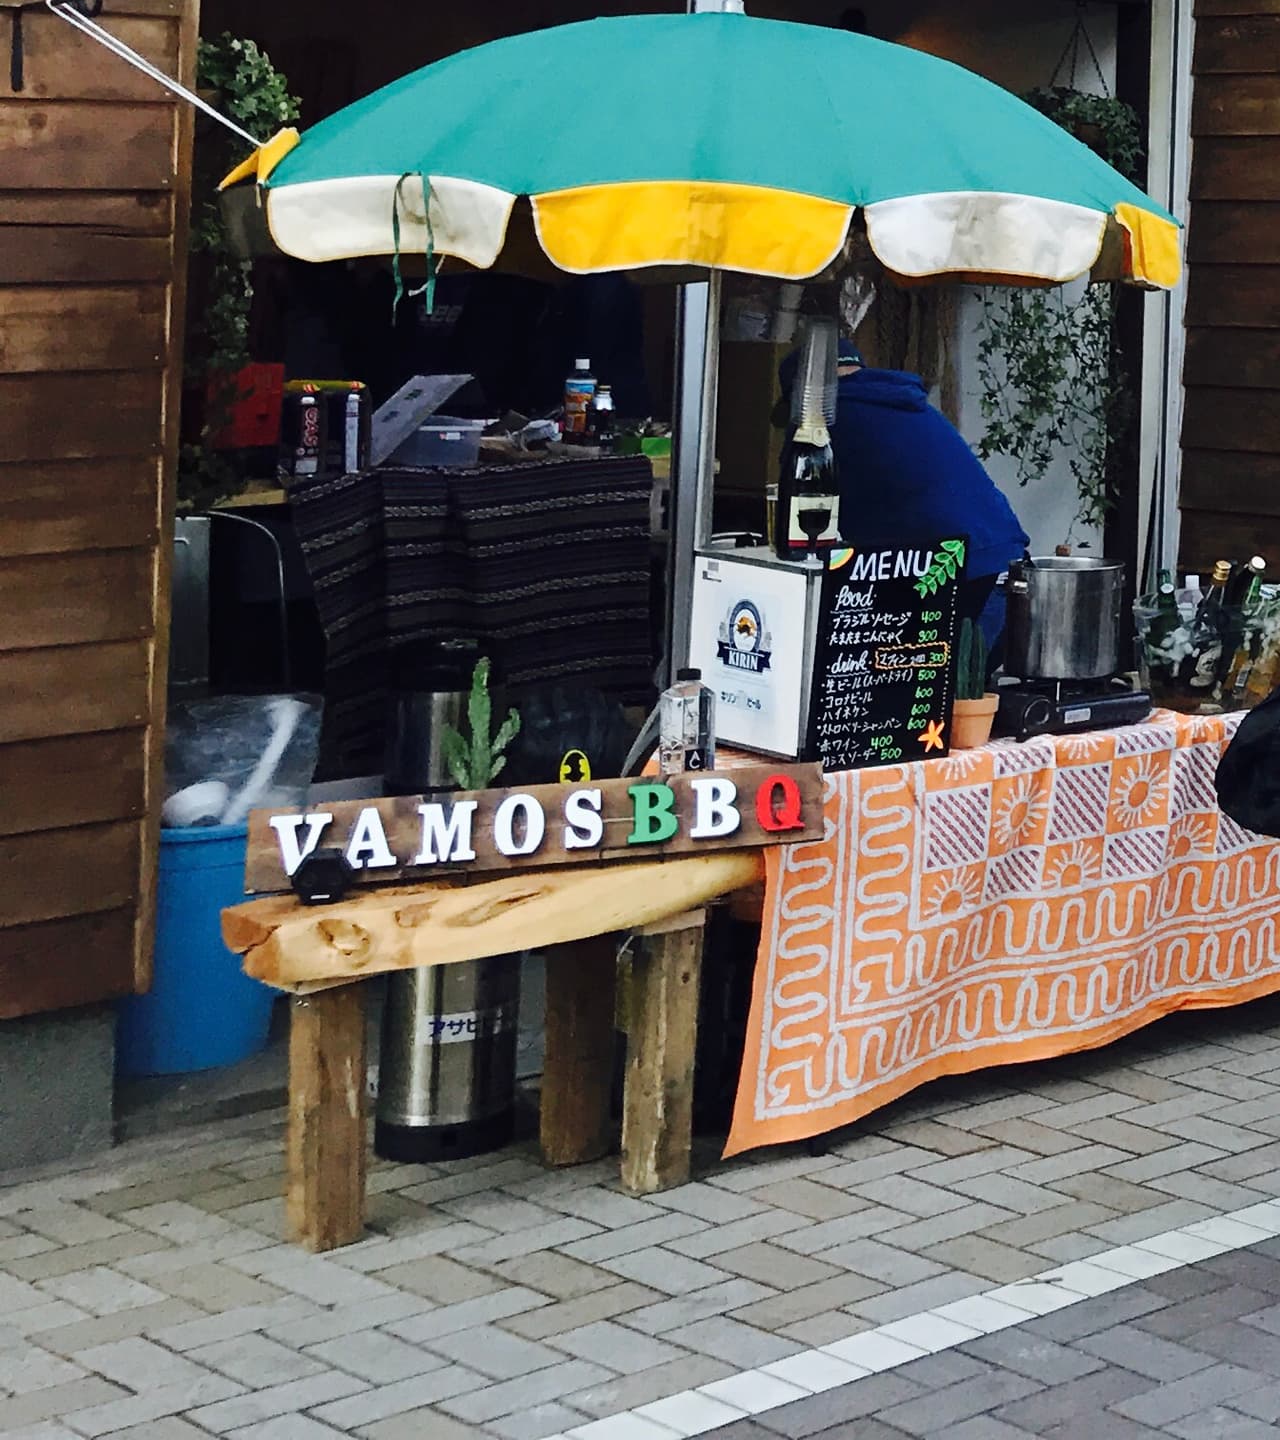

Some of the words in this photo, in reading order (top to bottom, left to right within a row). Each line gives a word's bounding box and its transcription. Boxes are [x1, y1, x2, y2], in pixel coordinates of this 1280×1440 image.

[849, 549, 933, 581] MENU
[836, 584, 874, 610] food
[921, 611, 942, 623] 400
[728, 650, 759, 671] KIRIN
[918, 669, 937, 681] 500
[915, 687, 934, 698] 600
[911, 704, 931, 716] 600
[907, 718, 927, 730] 600
[871, 735, 893, 750] 400
[880, 747, 902, 760] 500
[269, 788, 605, 876] VAMOS
[627, 773, 806, 845] BBQ
